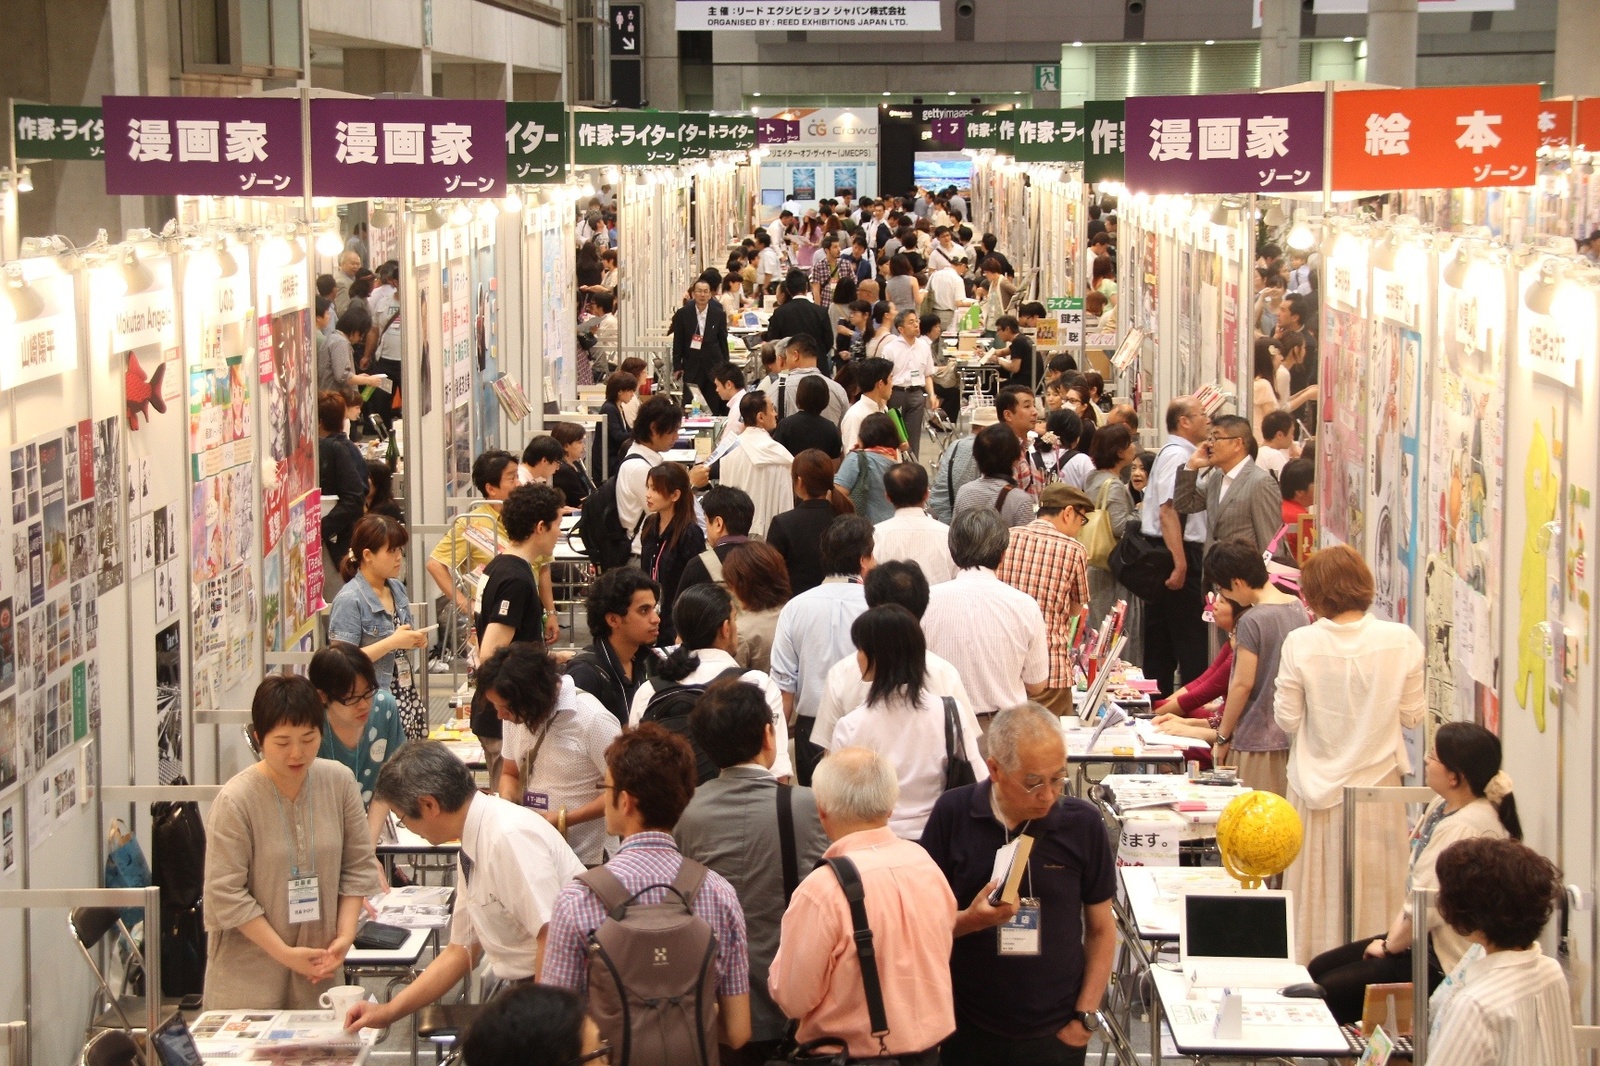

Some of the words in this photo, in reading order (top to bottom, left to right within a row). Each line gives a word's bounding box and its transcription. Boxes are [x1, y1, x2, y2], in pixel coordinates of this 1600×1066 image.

[128, 118, 269, 163] 漫画家
[335, 121, 473, 165] 漫画家
[578, 123, 675, 147] 作家・ライター
[1090, 119, 1125, 154] 作
[1149, 116, 1289, 162] 漫画家
[647, 151, 675, 162] ゾーン
[682, 146, 706, 156] ゾーン
[517, 162, 559, 178] ゾーン
[1258, 168, 1311, 187] ゾーン
[1473, 164, 1528, 182] ゾーン
[239, 172, 291, 191] ゾーン
[444, 174, 495, 193] ゾーン
[1047, 299, 1081, 308] ライター
